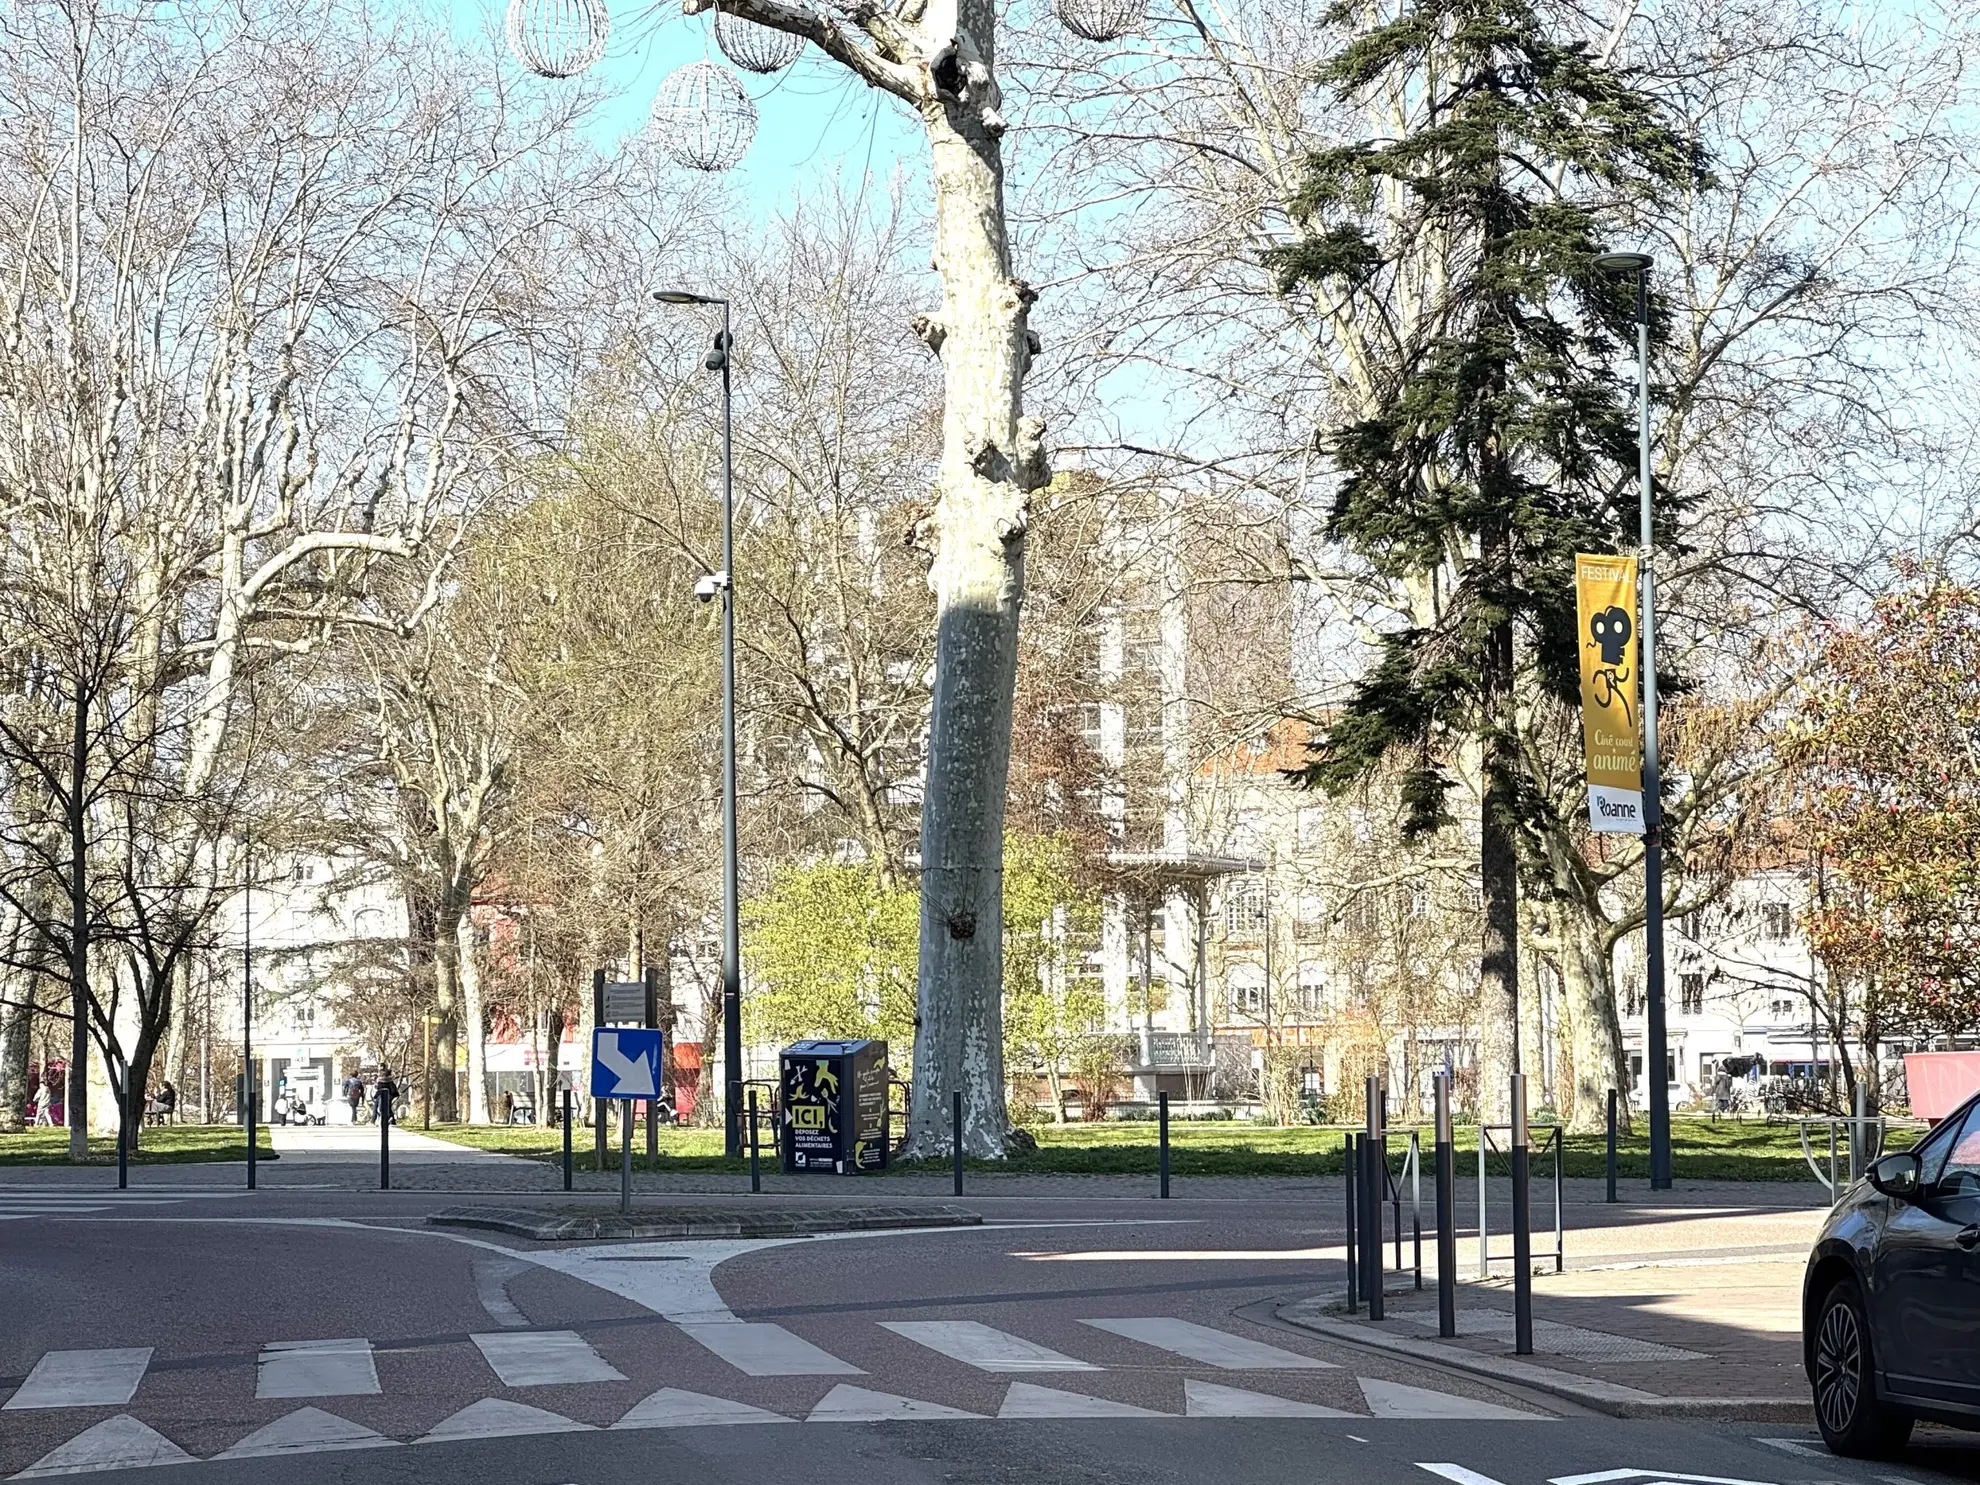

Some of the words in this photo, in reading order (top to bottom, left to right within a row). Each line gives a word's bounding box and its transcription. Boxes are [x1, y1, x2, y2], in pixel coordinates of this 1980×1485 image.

[1581, 565, 1633, 583] FESTIVAL
[1594, 729, 1613, 747] Ciné
[1593, 748, 1637, 772] animé
[1596, 795, 1636, 818] Roanne
[795, 1109, 823, 1127] ICI,
